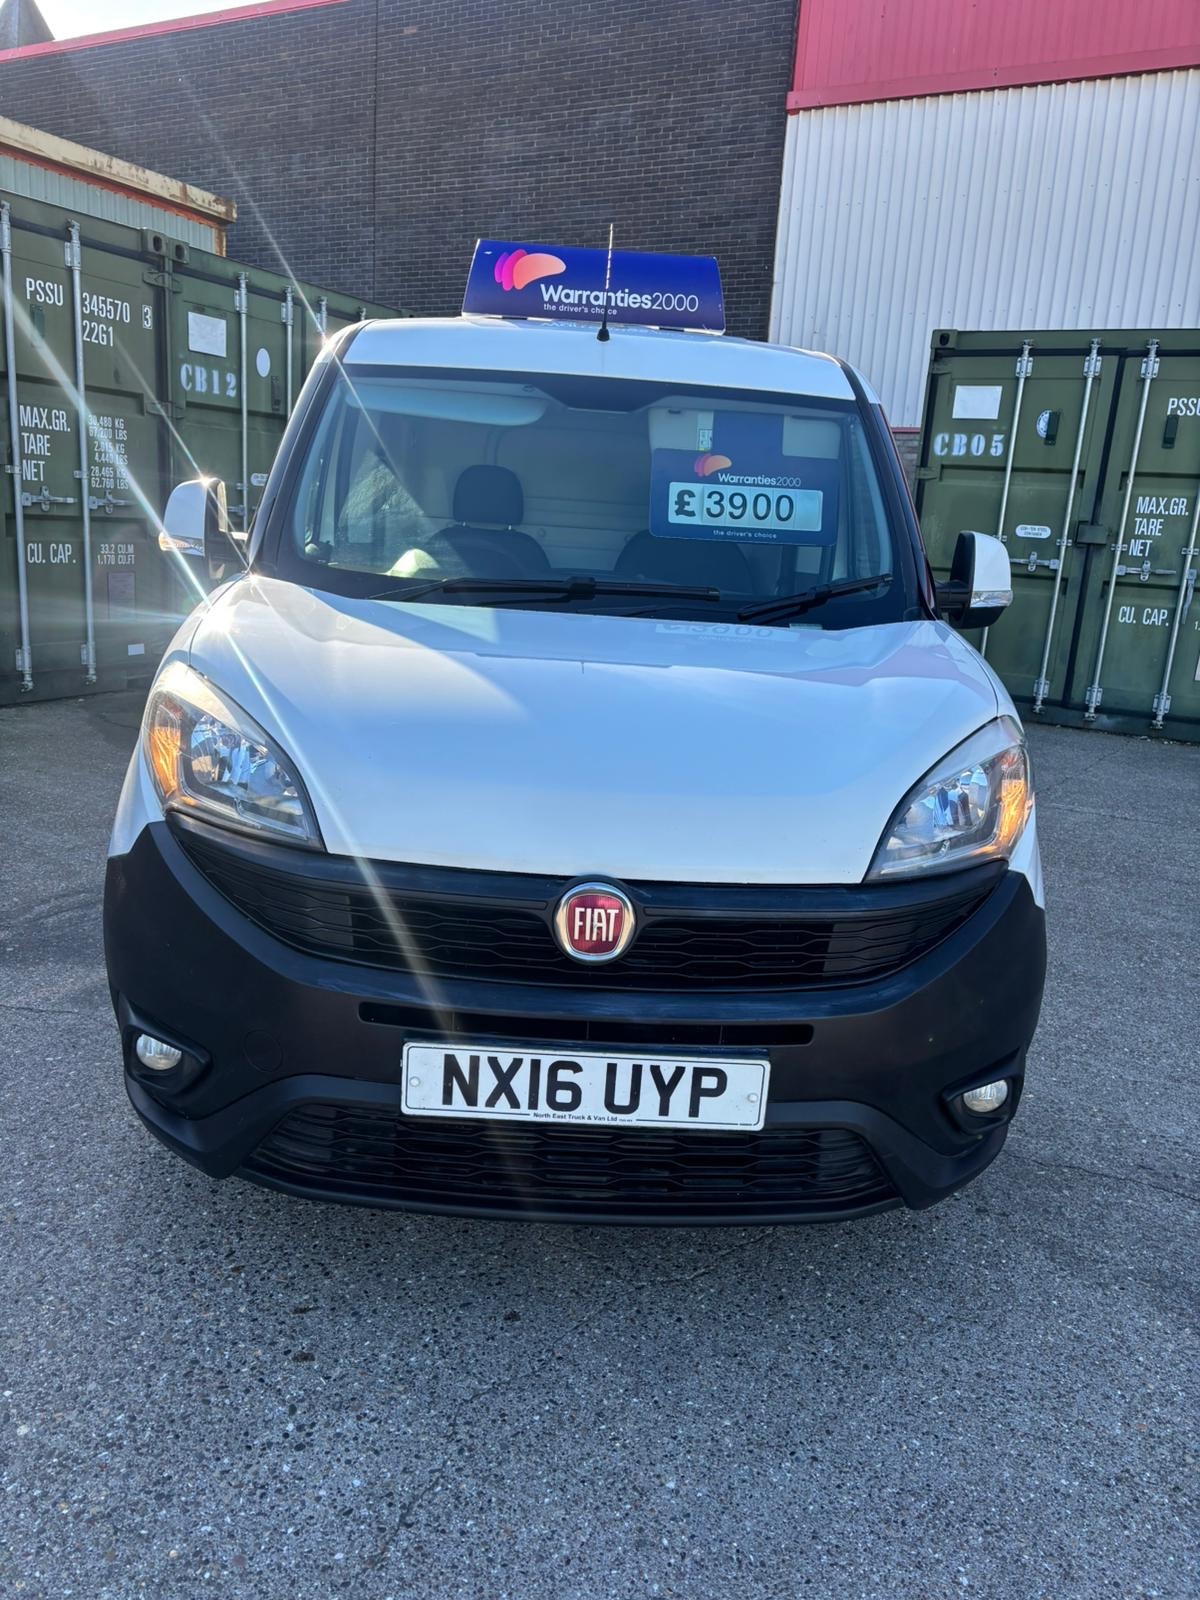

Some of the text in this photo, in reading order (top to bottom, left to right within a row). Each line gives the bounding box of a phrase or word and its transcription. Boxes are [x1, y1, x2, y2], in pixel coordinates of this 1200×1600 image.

[26, 277, 152, 328] PSSU 345570 3
[540, 283, 699, 312] Warranties2000
[543, 303, 618, 315] the driver's choce
[82, 320, 114, 347] 22G1
[180, 363, 237, 398] CB12
[20, 405, 71, 432] MAX.GR.
[21, 432, 51, 456] TARE
[115, 429, 128, 440] LBS
[933, 432, 1005, 457] CB05
[22, 459, 46, 482] NET
[718, 472, 802, 487] Warranties2000
[1136, 496, 1189, 516] MAX.GR.
[754, 531, 777, 539] choice
[1134, 517, 1164, 536] TARE
[27, 543, 46, 564] CU.
[49, 543, 76, 564] CAP.
[1128, 539, 1152, 557] NET
[1118, 605, 1169, 627] CU. CAP.
[573, 907, 619, 942] FIAT
[441, 1053, 728, 1118] NX16 UYP
